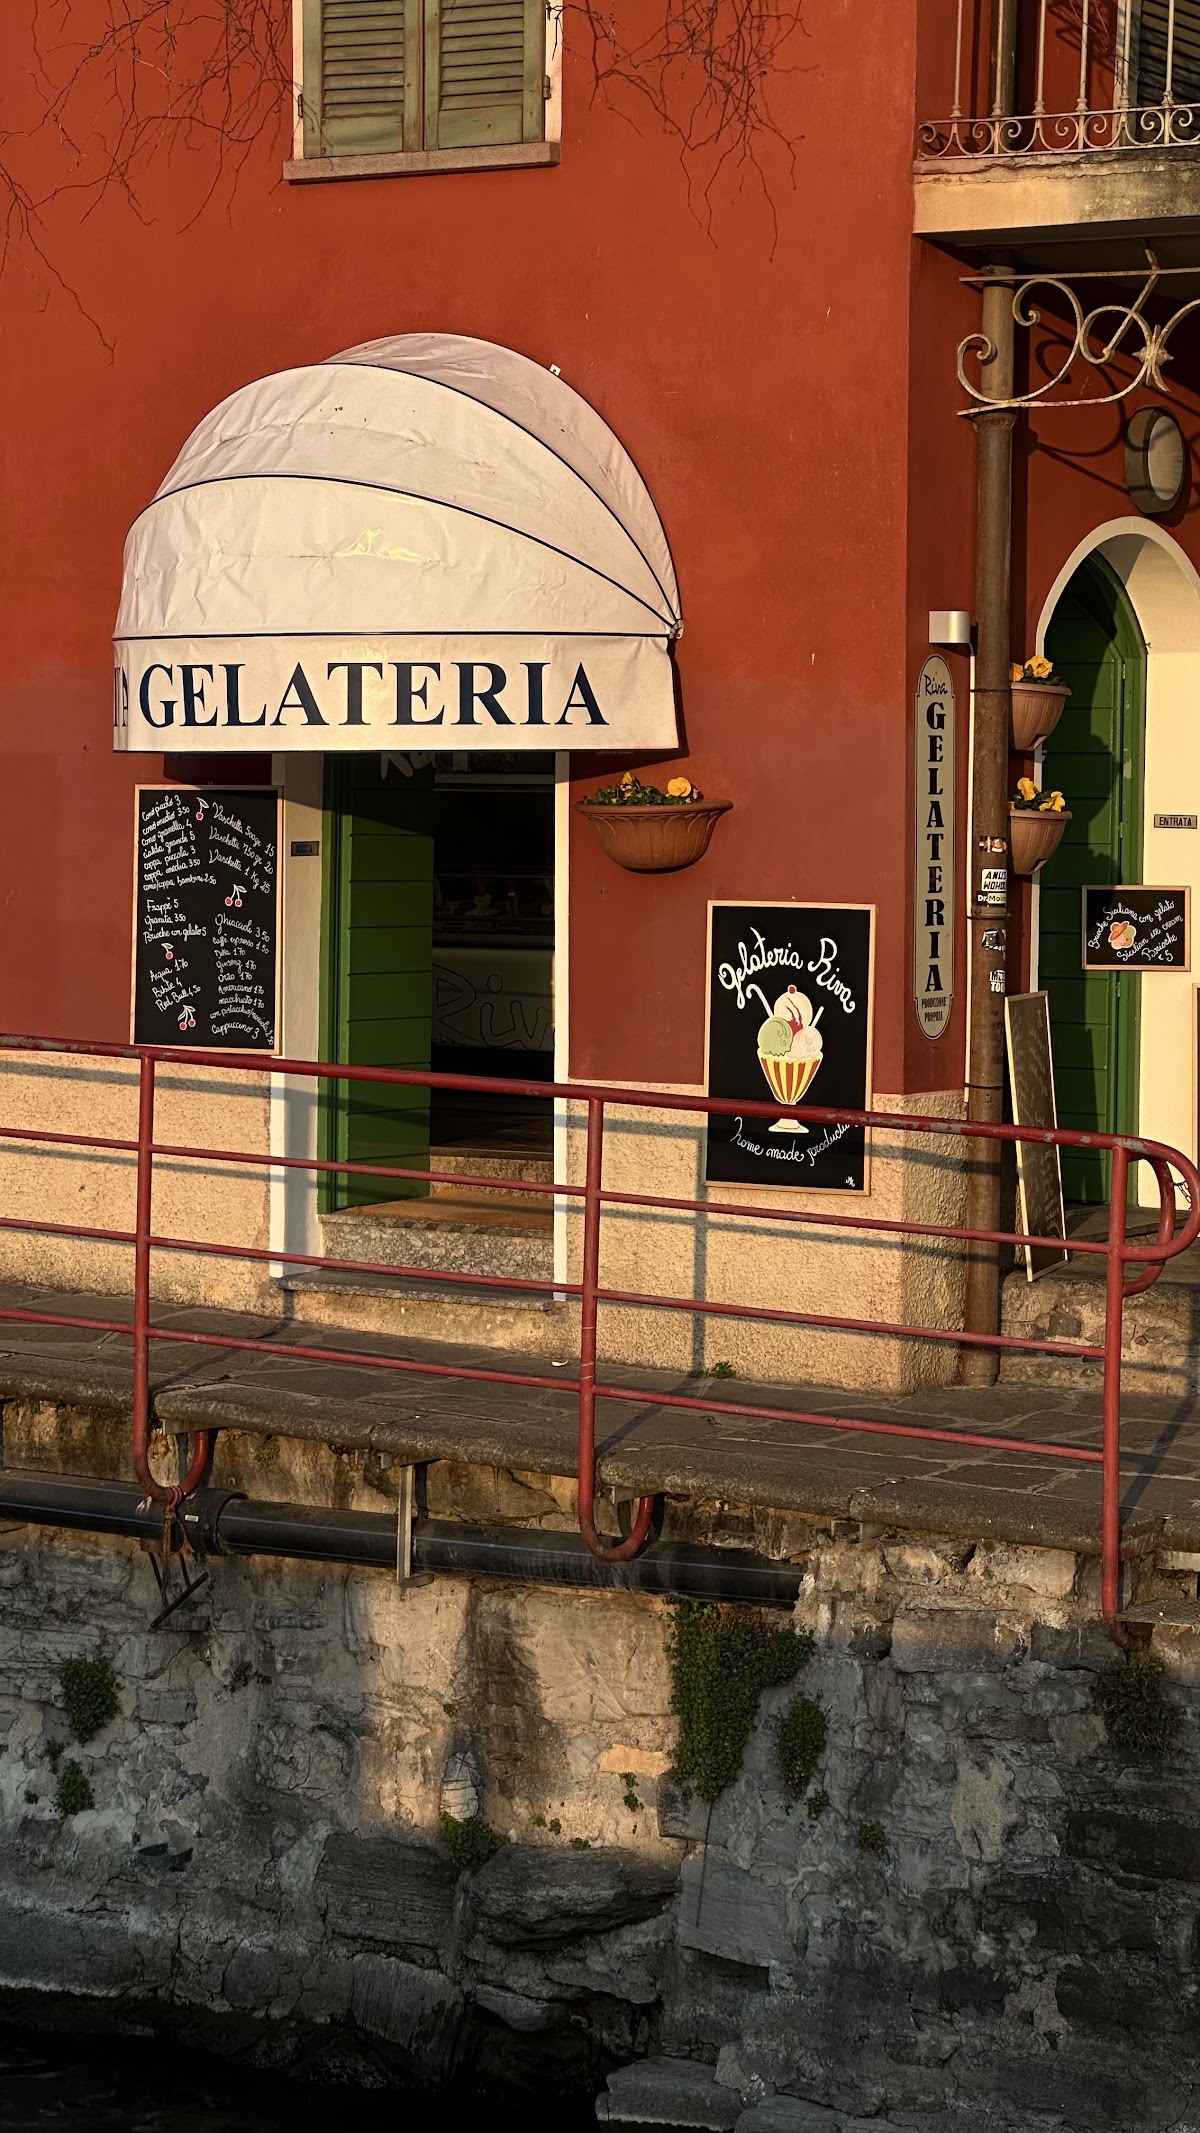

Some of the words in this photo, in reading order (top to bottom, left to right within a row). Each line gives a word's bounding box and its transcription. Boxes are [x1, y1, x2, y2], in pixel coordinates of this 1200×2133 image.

[924, 673, 948, 696] Riva
[139, 662, 610, 728] GELATERIA
[174, 795, 181, 806] 3
[186, 819, 193, 828] 4
[1159, 816, 1192, 826] ENTRATA
[189, 830, 195, 841] 5
[190, 845, 196, 854] 3
[264, 843, 275, 857] 15
[924, 701, 946, 993] GELATERIA
[264, 861, 273, 875] 20
[174, 899, 179, 908] 5
[1088, 921, 1108, 949] Brioche
[1139, 914, 1154, 923] con
[1154, 900, 1175, 921] gelato
[1162, 914, 1184, 930] cream
[1141, 932, 1178, 961] Brioche
[808, 938, 855, 1013] Riva
[251, 1028, 260, 1039] 3
[730, 1116, 764, 1155] home
[766, 1140, 804, 1162] made
